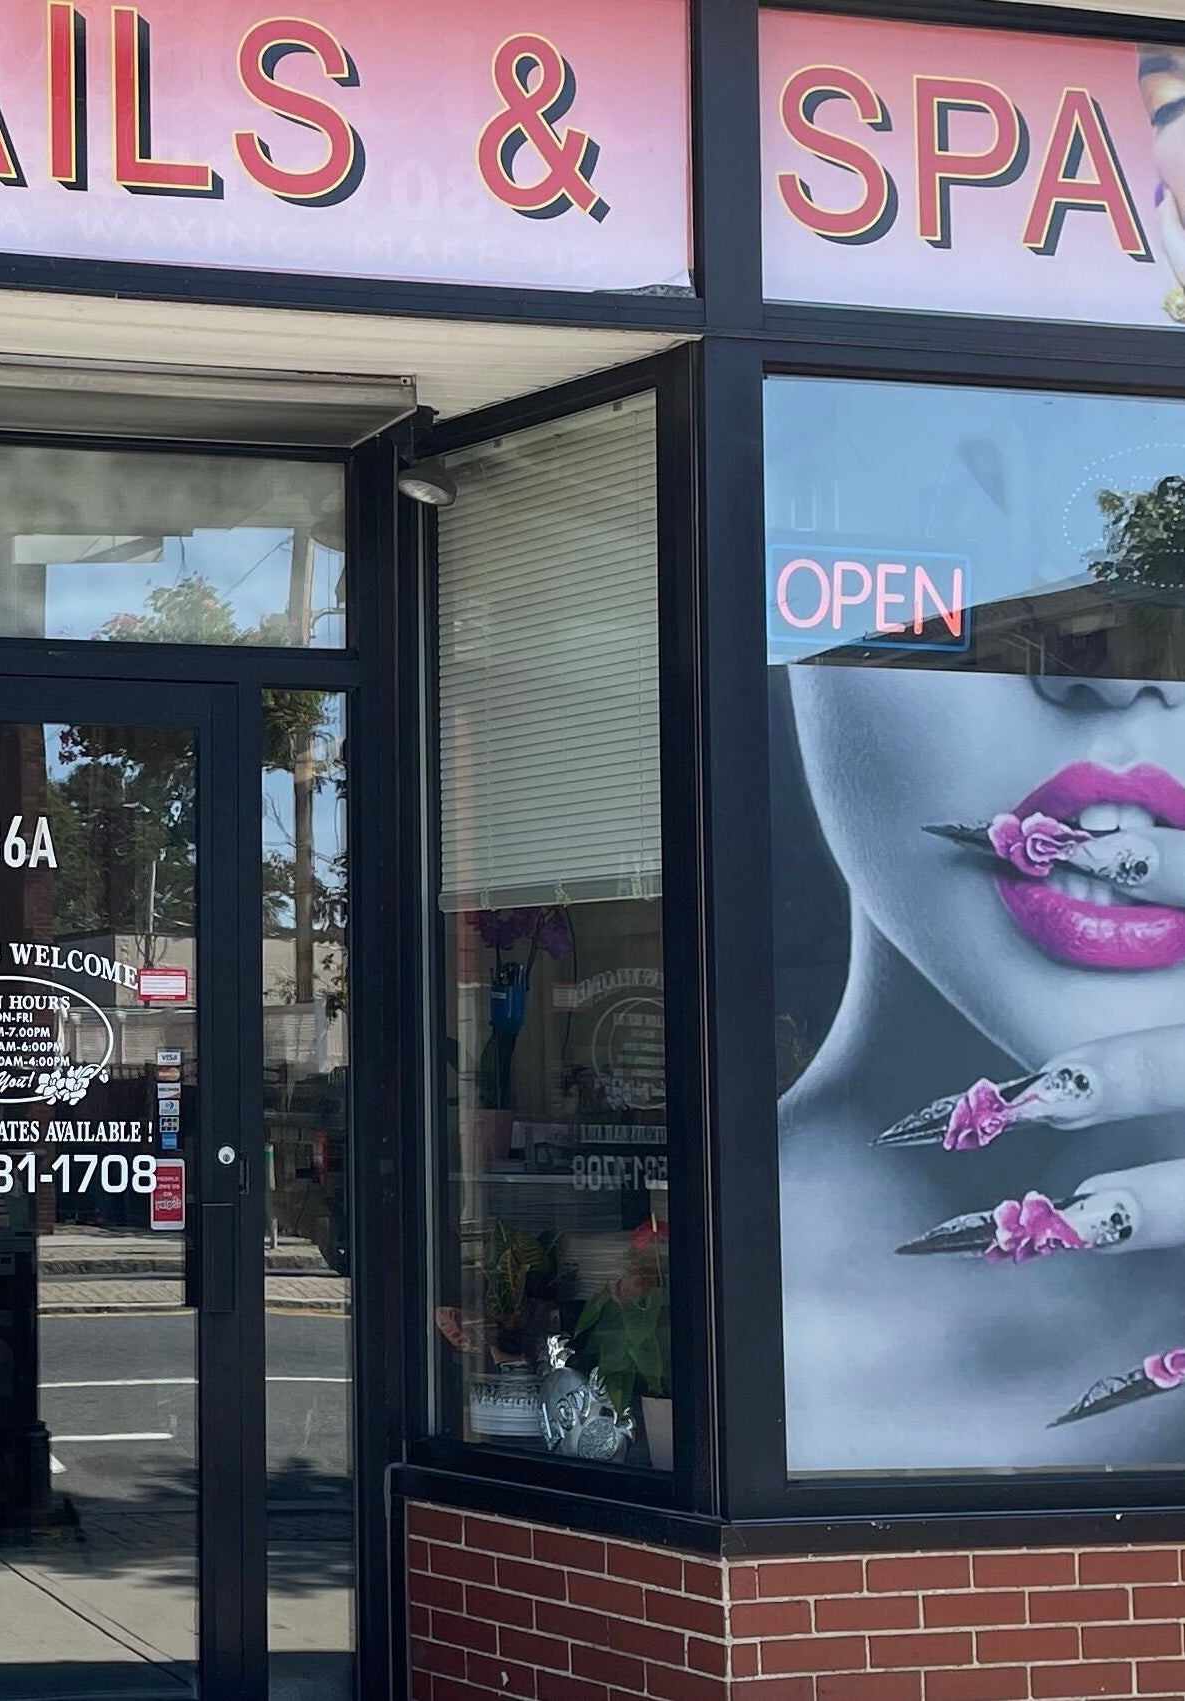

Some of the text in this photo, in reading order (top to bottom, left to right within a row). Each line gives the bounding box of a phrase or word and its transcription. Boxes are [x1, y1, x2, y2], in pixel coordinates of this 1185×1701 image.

[477, 32, 611, 226] &
[776, 63, 1155, 264] SPA
[776, 557, 963, 638] OPEN
[9, 942, 139, 990] WELCOME
[8, 995, 71, 1011] HOURS
[45, 1122, 142, 1143] AVAILABLE
